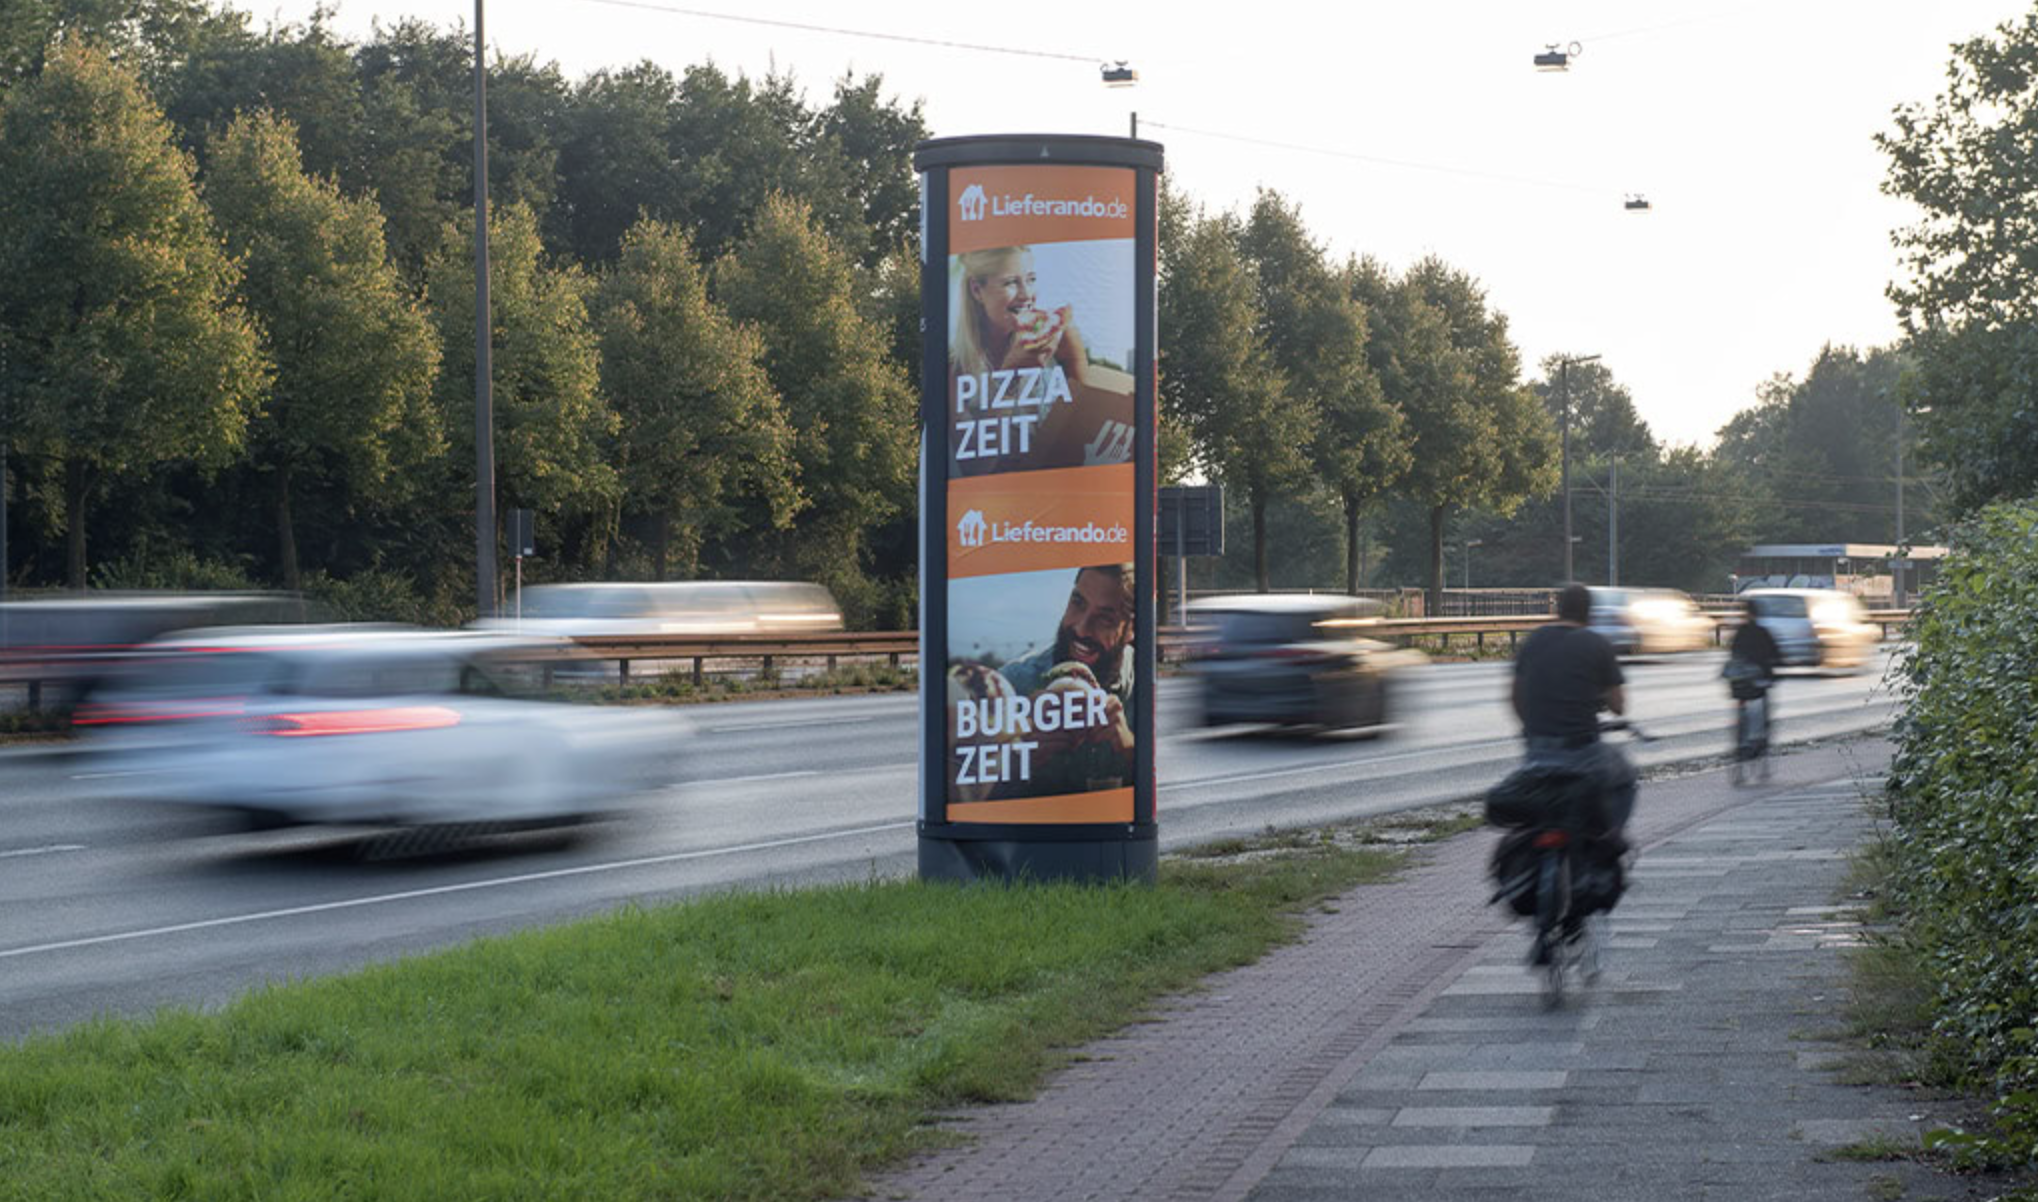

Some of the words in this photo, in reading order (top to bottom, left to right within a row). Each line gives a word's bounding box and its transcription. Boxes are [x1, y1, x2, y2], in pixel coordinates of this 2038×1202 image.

[992, 194, 1127, 218] Lieferando.de
[956, 365, 1072, 412] PIZZA
[955, 414, 1038, 460] ZEIT
[992, 520, 1127, 543] Lieferando.de
[957, 689, 1108, 738] BURGER
[955, 742, 1038, 785] ZEIT
